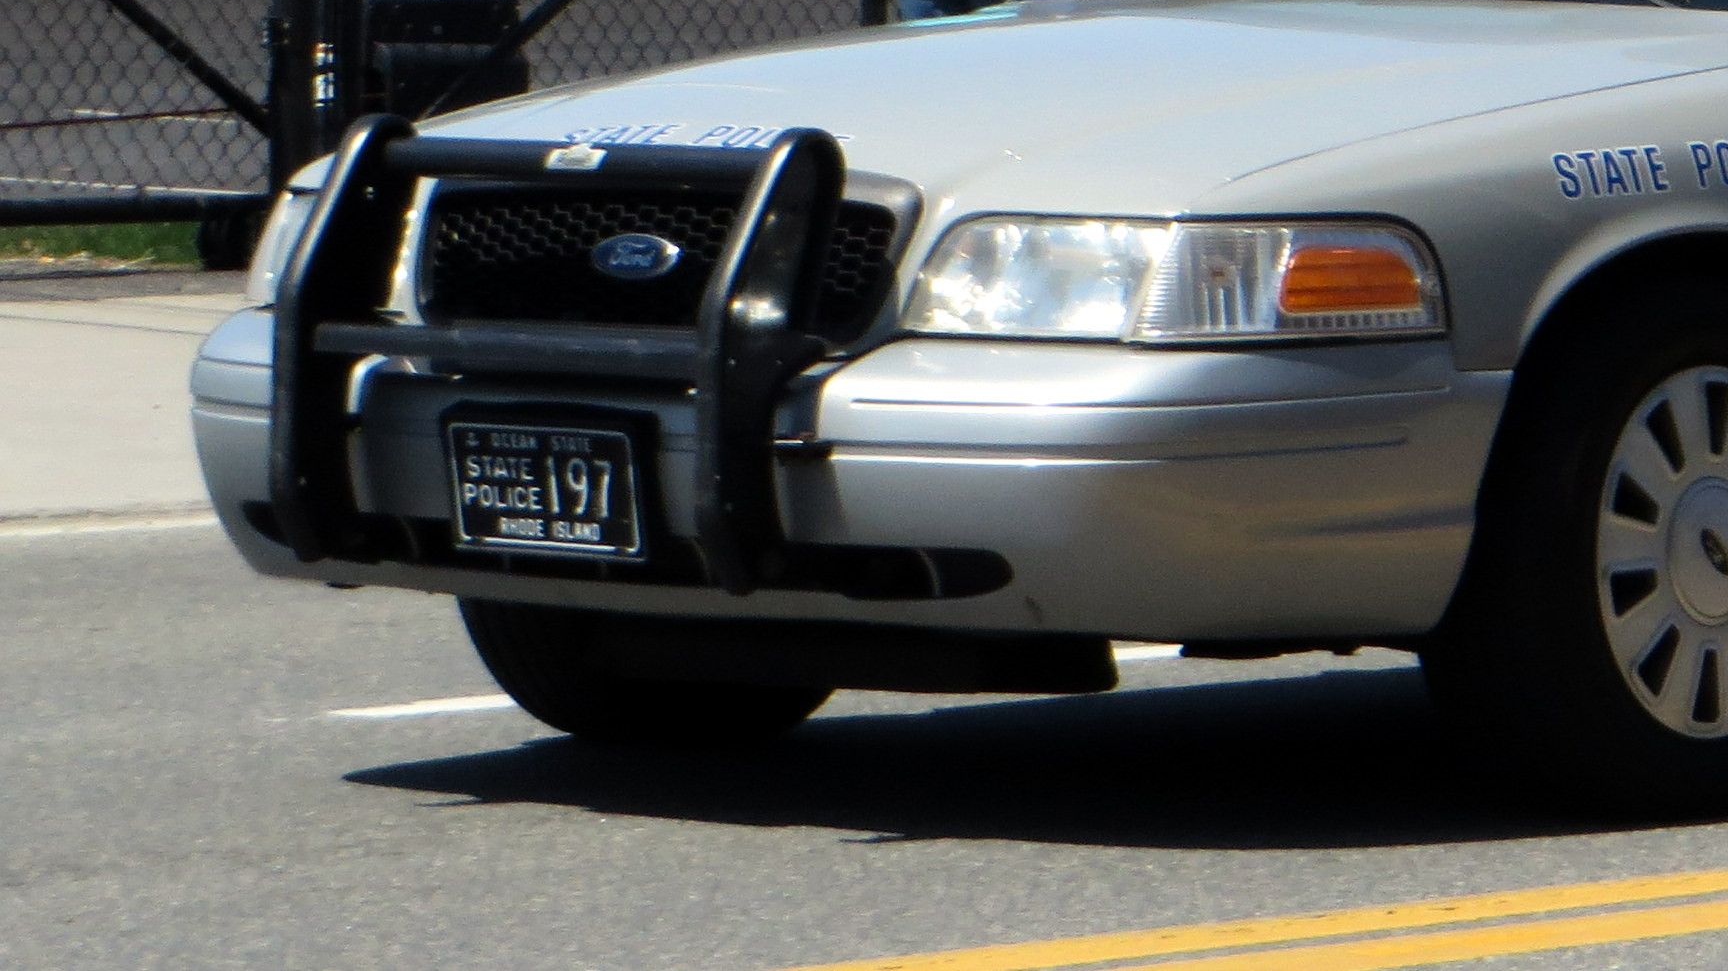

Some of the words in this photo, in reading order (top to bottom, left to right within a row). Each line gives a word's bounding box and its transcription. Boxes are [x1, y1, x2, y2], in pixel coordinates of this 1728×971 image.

[1552, 144, 1669, 200] STATE
[465, 455, 535, 480] STATE
[463, 482, 543, 510] POLICE
[546, 455, 612, 518] 197
[499, 516, 545, 537] RHODE
[551, 521, 600, 541] ISLAND
